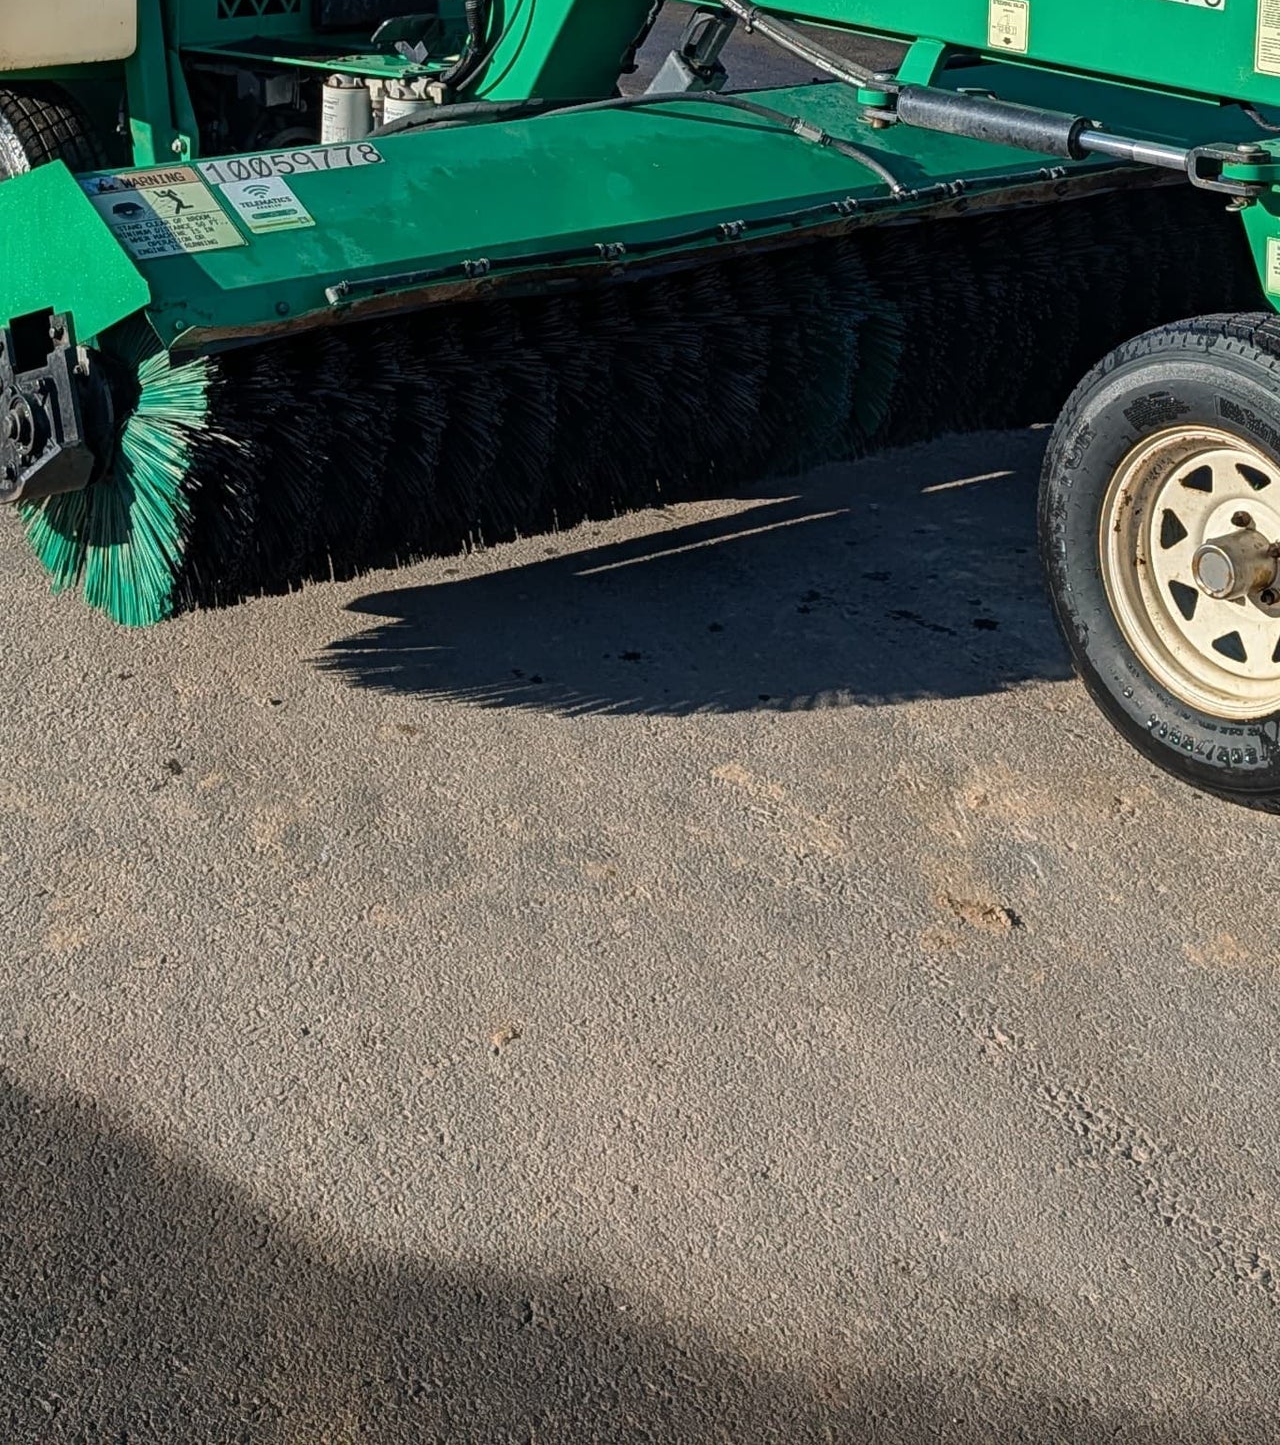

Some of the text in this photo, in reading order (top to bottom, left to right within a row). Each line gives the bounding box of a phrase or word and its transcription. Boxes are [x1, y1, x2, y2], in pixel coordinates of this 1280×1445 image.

[205, 143, 383, 183] 10059778
[120, 171, 186, 189] WARNING
[238, 196, 293, 209] TELEMATICS
